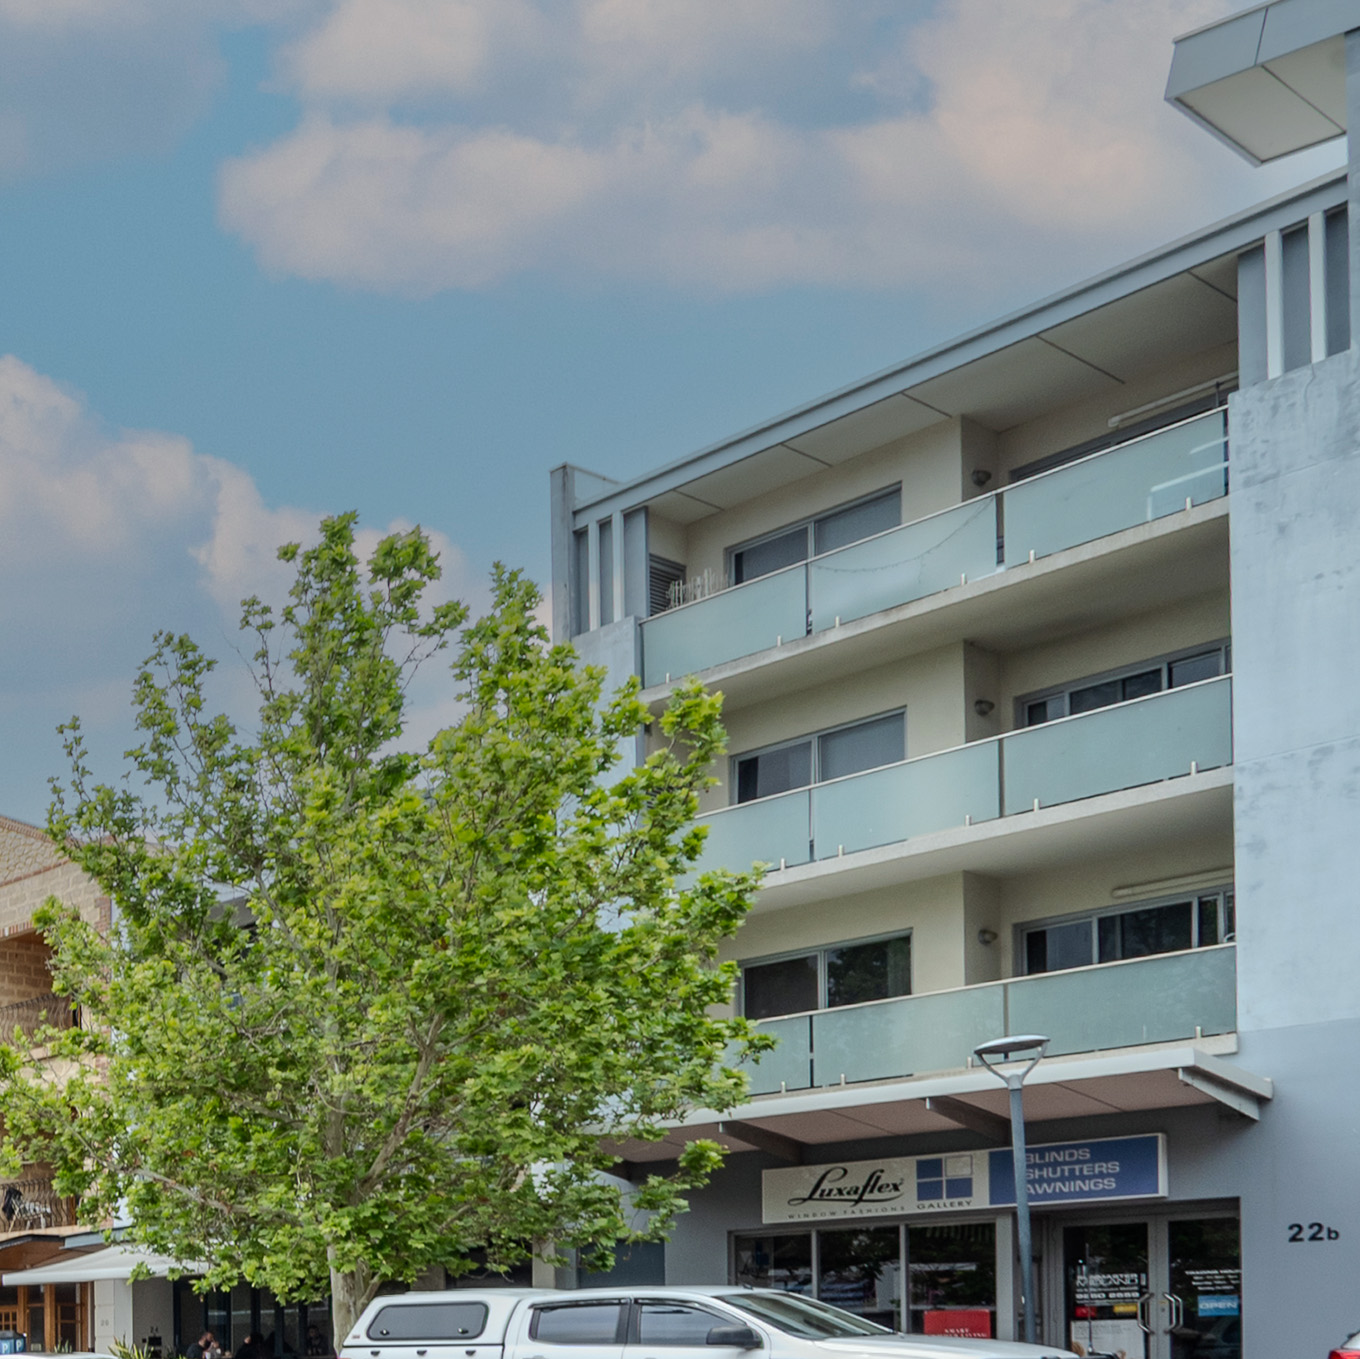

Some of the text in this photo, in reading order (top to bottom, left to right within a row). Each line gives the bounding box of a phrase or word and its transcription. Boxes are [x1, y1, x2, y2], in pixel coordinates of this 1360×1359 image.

[1025, 1148, 1091, 1165] BLINDS
[1025, 1161, 1120, 1180] SHUTTERS
[788, 1166, 904, 1207] Luxaflex
[1026, 1178, 1116, 1195] AWNINGS
[788, 1206, 905, 1219] WINDOW FASHIONS
[917, 1200, 972, 1210] GALLERY
[1288, 1222, 1340, 1242] 22b
